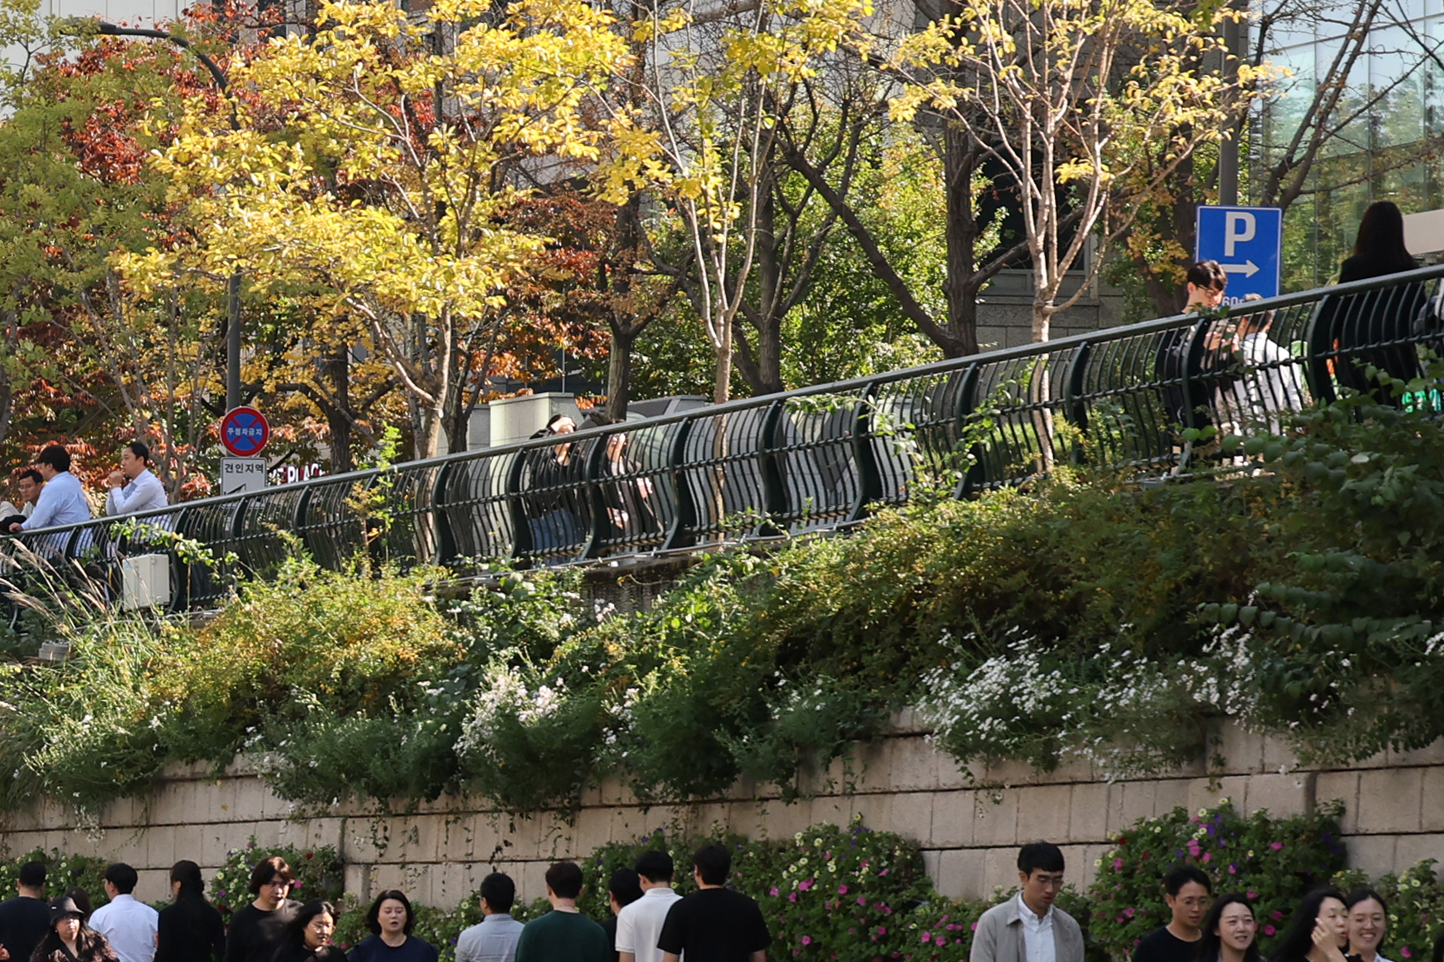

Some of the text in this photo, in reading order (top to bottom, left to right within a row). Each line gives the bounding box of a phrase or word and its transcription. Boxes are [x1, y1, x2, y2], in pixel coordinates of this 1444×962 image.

[1224, 211, 1256, 257] P
[227, 427, 263, 436] 주정차금지
[224, 463, 264, 473] 견인지역
